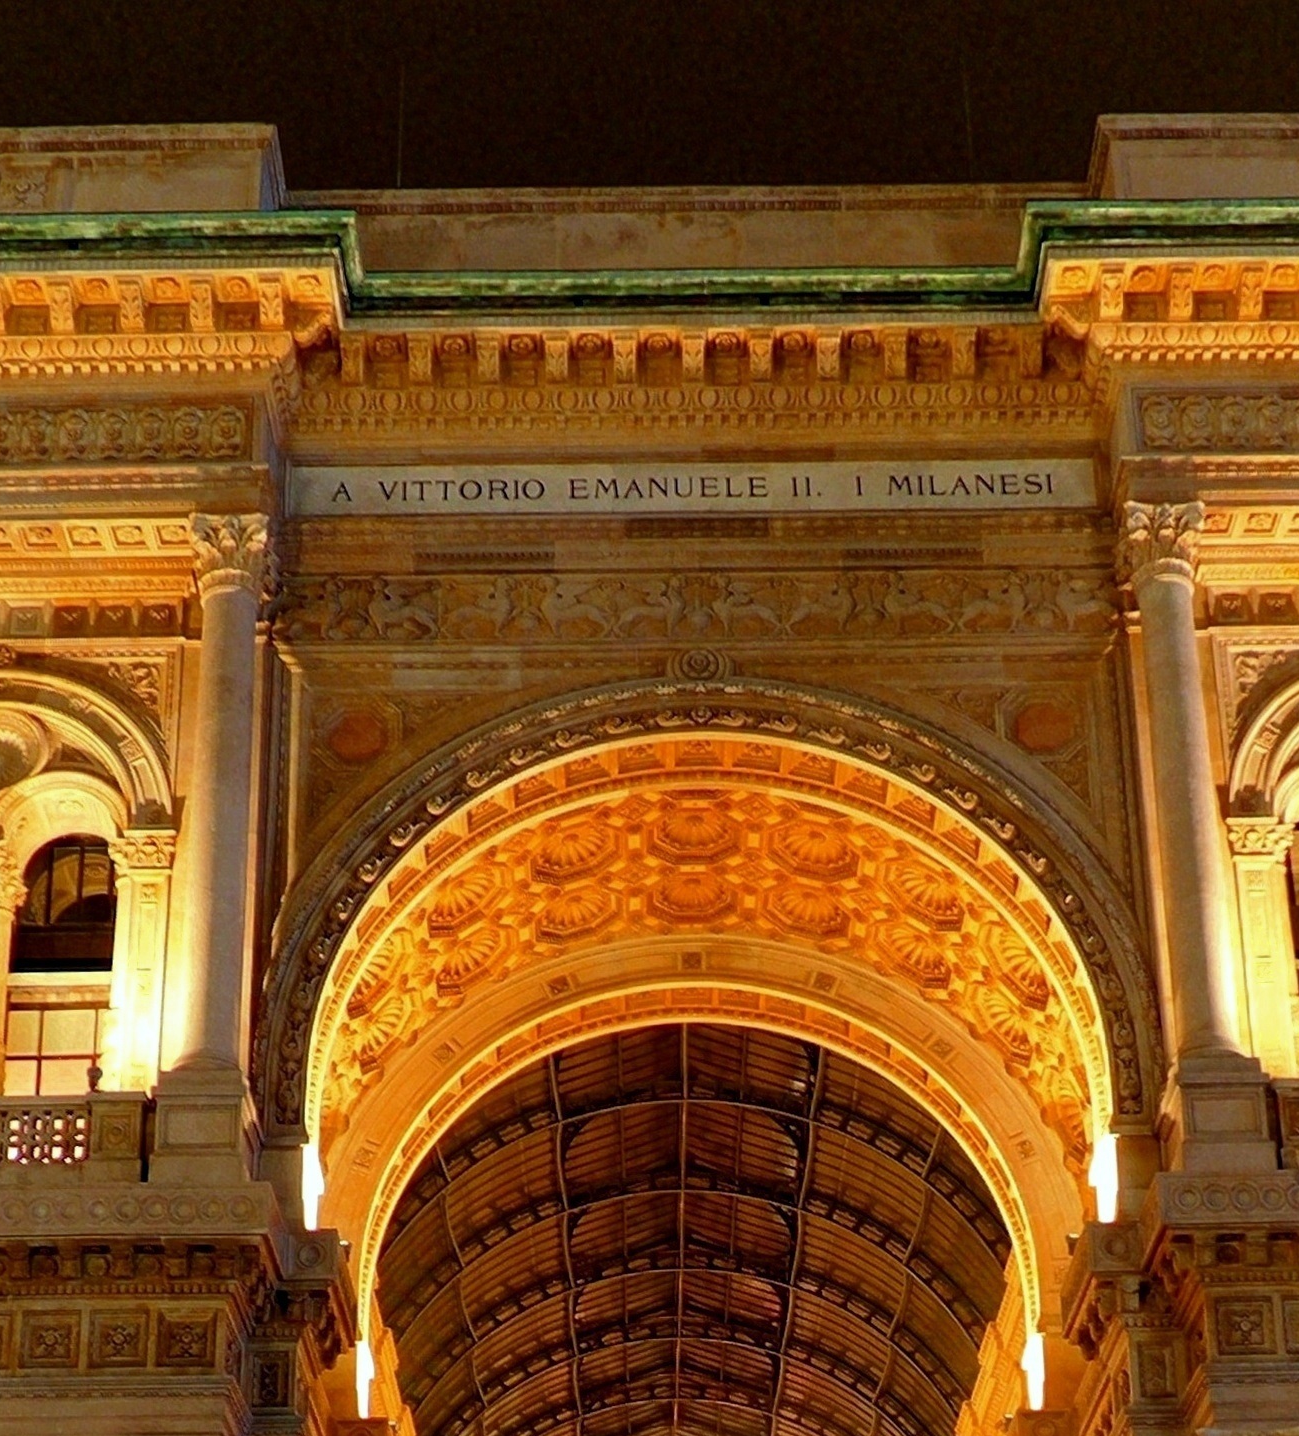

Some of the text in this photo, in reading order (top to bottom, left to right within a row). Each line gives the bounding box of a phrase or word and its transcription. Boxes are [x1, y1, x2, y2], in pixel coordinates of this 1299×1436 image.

[331, 482, 353, 501] A
[378, 478, 546, 501] VITTORIO
[568, 476, 769, 500] EMANUELE
[855, 476, 864, 496] I
[888, 473, 1054, 496] MILANESI
